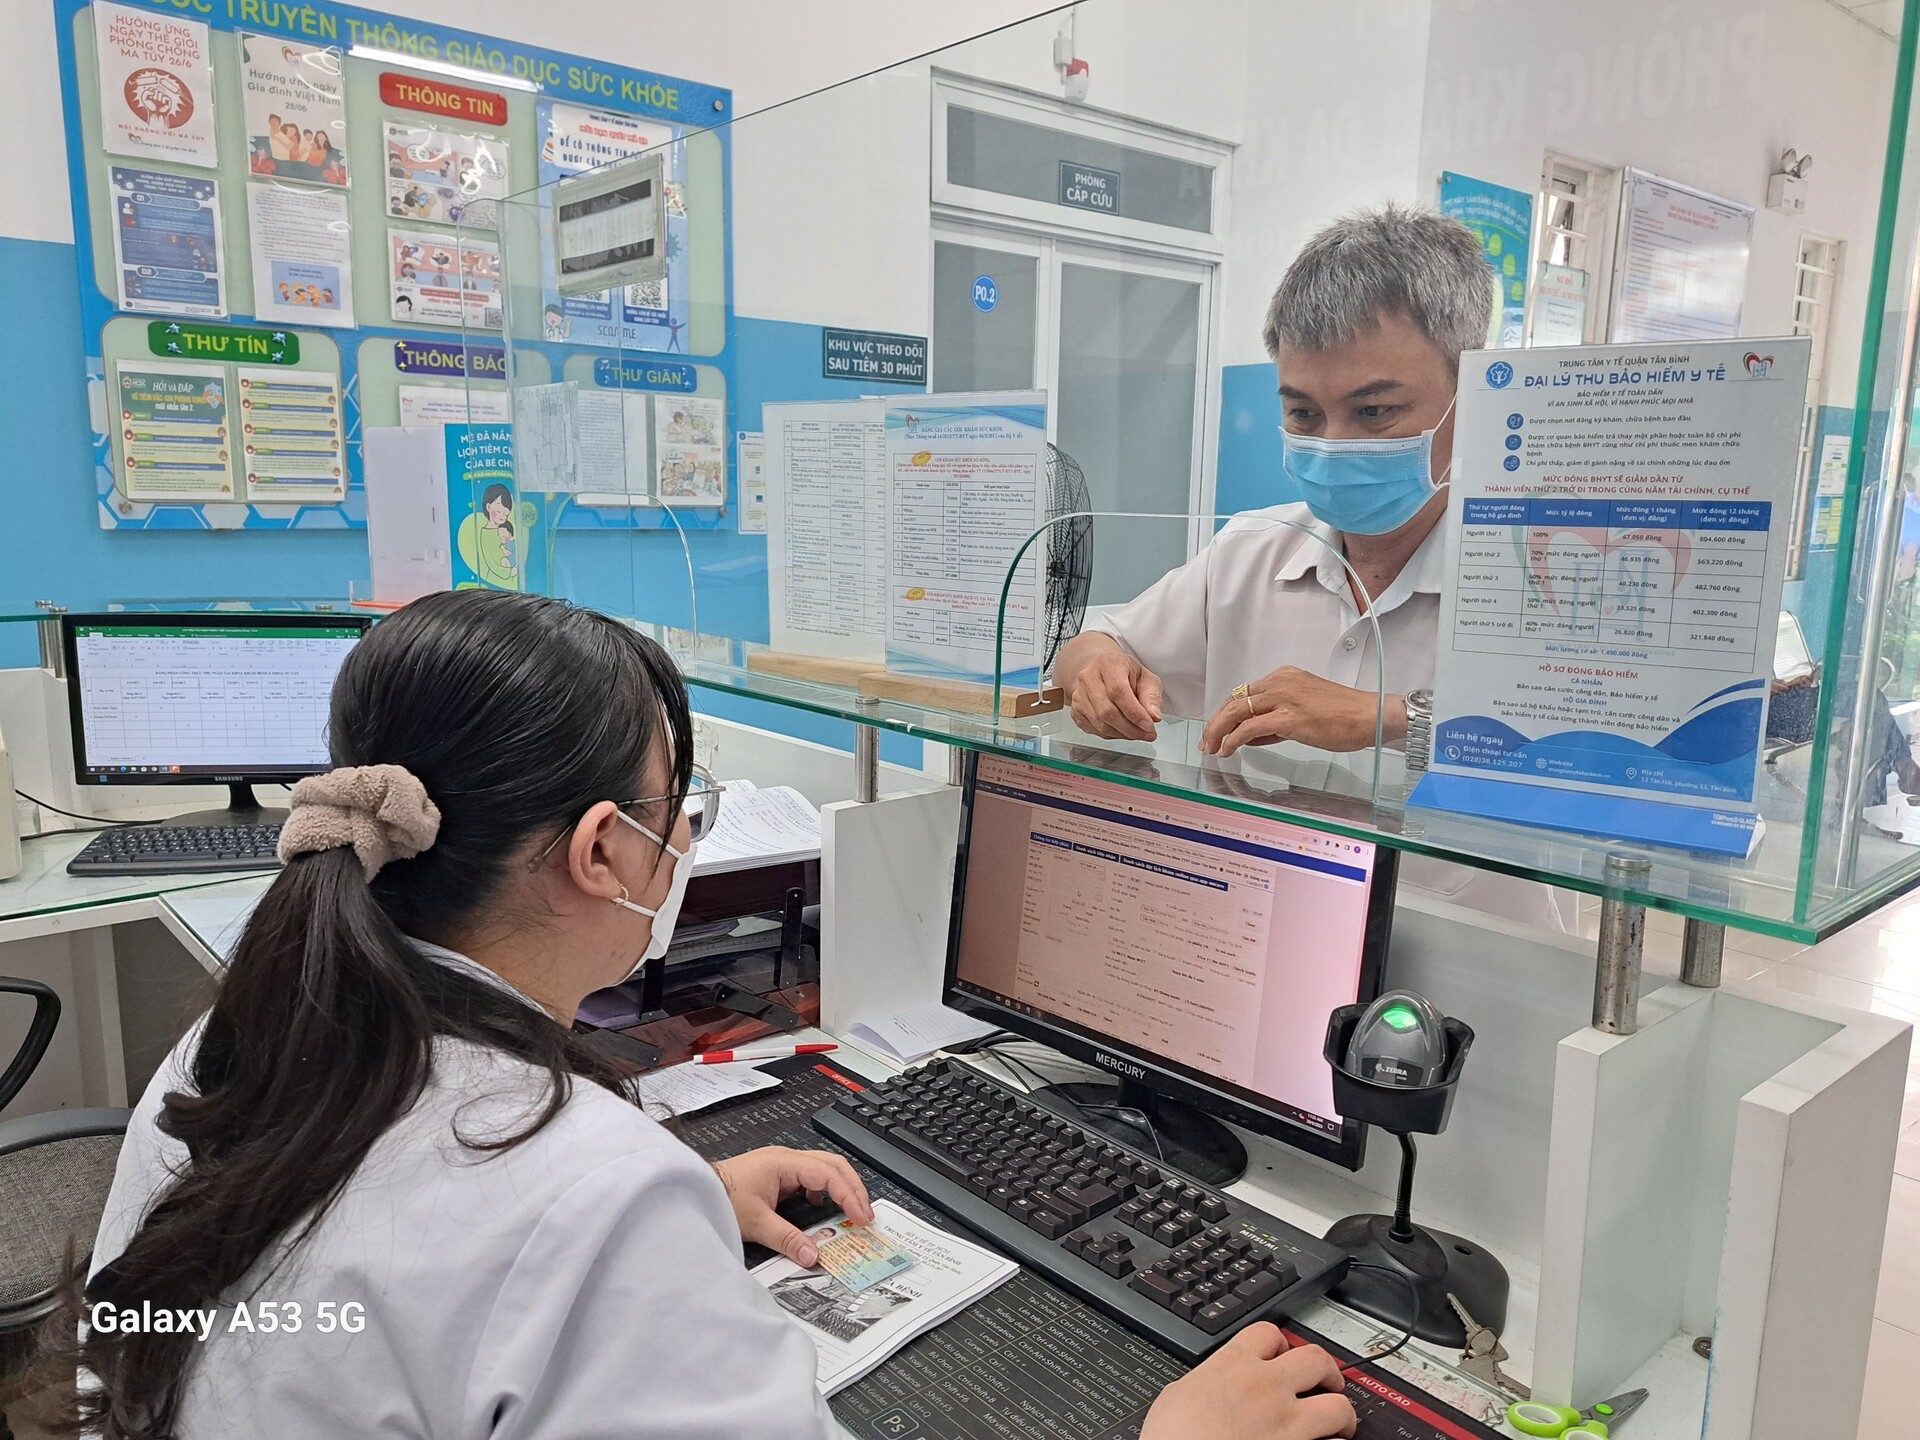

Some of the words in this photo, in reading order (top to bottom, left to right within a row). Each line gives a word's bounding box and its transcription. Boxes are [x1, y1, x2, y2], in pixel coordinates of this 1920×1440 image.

[165, 24, 190, 37] ỨNG
[121, 49, 139, 58] MA
[169, 57, 192, 68] 26/6
[346, 18, 437, 59] THÔNG
[446, 40, 505, 72] GIÁO
[513, 55, 561, 86] DỤC
[568, 65, 614, 97] SỨC
[248, 82, 265, 93] Gia
[295, 90, 316, 102] Việt
[318, 95, 340, 106] Nam
[395, 81, 461, 111] THÔNG
[465, 96, 494, 117] TIN
[285, 102, 307, 112] 28/06
[1075, 172, 1106, 189] PHÒNG
[1090, 189, 1113, 208] CỨU
[975, 285, 995, 303] P0.2
[182, 332, 229, 352] THƯ
[234, 335, 268, 355] TÍN
[828, 339, 850, 351] KHU
[853, 341, 874, 356] VỰC
[876, 343, 902, 356] THEO
[905, 344, 923, 358] DÕI
[404, 349, 465, 368] THÔNG
[828, 357, 849, 370] SAU
[852, 356, 878, 373] TIÊM
[881, 362, 893, 374] 30
[896, 360, 923, 377] PHÚT
[1559, 360, 1586, 368] TRUNG
[1587, 358, 1604, 367] TÂM
[1614, 356, 1624, 366] TẾ
[1624, 356, 1648, 367] QUẬN
[1650, 355, 1667, 364] TÂN
[1669, 354, 1690, 364] BÌNH
[611, 366, 644, 382] THƯ
[646, 367, 682, 386] GIÃN
[1524, 375, 1548, 389] ĐẠI
[1552, 372, 1571, 387] LÝ
[1575, 373, 1604, 385] THU
[1609, 368, 1642, 384] BẢO
[1646, 366, 1685, 383] HIỂM
[1706, 363, 1725, 381] TẾ
[1577, 390, 1591, 398] BẢO
[1593, 389, 1611, 397] HIỂM
[1617, 388, 1625, 396] TẾ
[1627, 388, 1646, 396] TOÀN
[1648, 388, 1664, 396] DÂN
[1594, 399, 1609, 407] HỘI,
[1619, 398, 1639, 407] HẠNH
[1640, 397, 1660, 405] PHÚC
[1661, 397, 1677, 406] MỌI
[1677, 396, 1694, 404] NHÀ
[477, 430, 490, 441] ĐÃ
[479, 444, 500, 454] TIÊM
[486, 457, 496, 466] BÉ
[1542, 474, 1562, 483] MỨC
[1564, 474, 1588, 483] ĐÓNG
[1613, 474, 1624, 482] SẼ
[1625, 474, 1648, 483] GIẢM
[1650, 474, 1669, 483] DẦN
[1671, 474, 1684, 483] TỪ
[1484, 484, 1511, 493] THÀNH
[1513, 484, 1531, 493] VIÊN
[1533, 484, 1551, 493] THỨ
[1551, 485, 1557, 493] 2
[1559, 484, 1575, 493] TRỞ
[1588, 486, 1617, 494] TRONG
[1618, 485, 1643, 494] CÙNG
[1645, 485, 1666, 494] NĂM
[1668, 485, 1682, 494] TÀI
[1684, 485, 1715, 496] CHÍNH,
[1717, 487, 1730, 496] CỤ
[1732, 485, 1750, 495] THỂ
[1720, 610, 1738, 618] đồng
[1538, 662, 1552, 672] HỒ
[1554, 665, 1566, 673] SƠ
[1567, 665, 1593, 675] ĐÓNG
[1595, 667, 1613, 677] BẢO
[1615, 669, 1638, 679] HIỂM
[1581, 678, 1603, 686] NHÂN
[1588, 697, 1607, 706] ĐÌNH
[1446, 731, 1465, 740] Liên
[1467, 734, 1478, 743] hệ
[1480, 736, 1503, 746] ngay
[1463, 745, 1479, 753] Điện
[1481, 748, 1501, 756] thoại
[1514, 751, 1527, 759] vấn
[1095, 1051, 1147, 1081] MERCURY
[1384, 1066, 1408, 1077] ZEBRA
[1239, 1229, 1279, 1251] MITSUMI
[895, 1284, 923, 1298] BỆNH
[1074, 1311, 1109, 1334] Alt+Ctrl+A
[979, 1331, 999, 1347] Levels
[1046, 1325, 1086, 1353] Shift+Ctrl+L
[1059, 1318, 1099, 1346] Ctrl+Shift+G
[964, 1338, 985, 1355] Curves
[1032, 1333, 1084, 1369] Ctrl+Alt+Shift+S
[1018, 1341, 1070, 1377] Ctrl+Alt+Shift+E
[941, 1381, 970, 1403] Shift+F6
[1358, 1376, 1388, 1394] AUTO
[1388, 1391, 1411, 1407] CAD
[1076, 1401, 1100, 1420] Phóng
[1100, 1417, 1109, 1426] to
[883, 1415, 906, 1433] Ps
[1063, 1411, 1078, 1424] Thu
[1078, 1422, 1094, 1435] nhỏ
